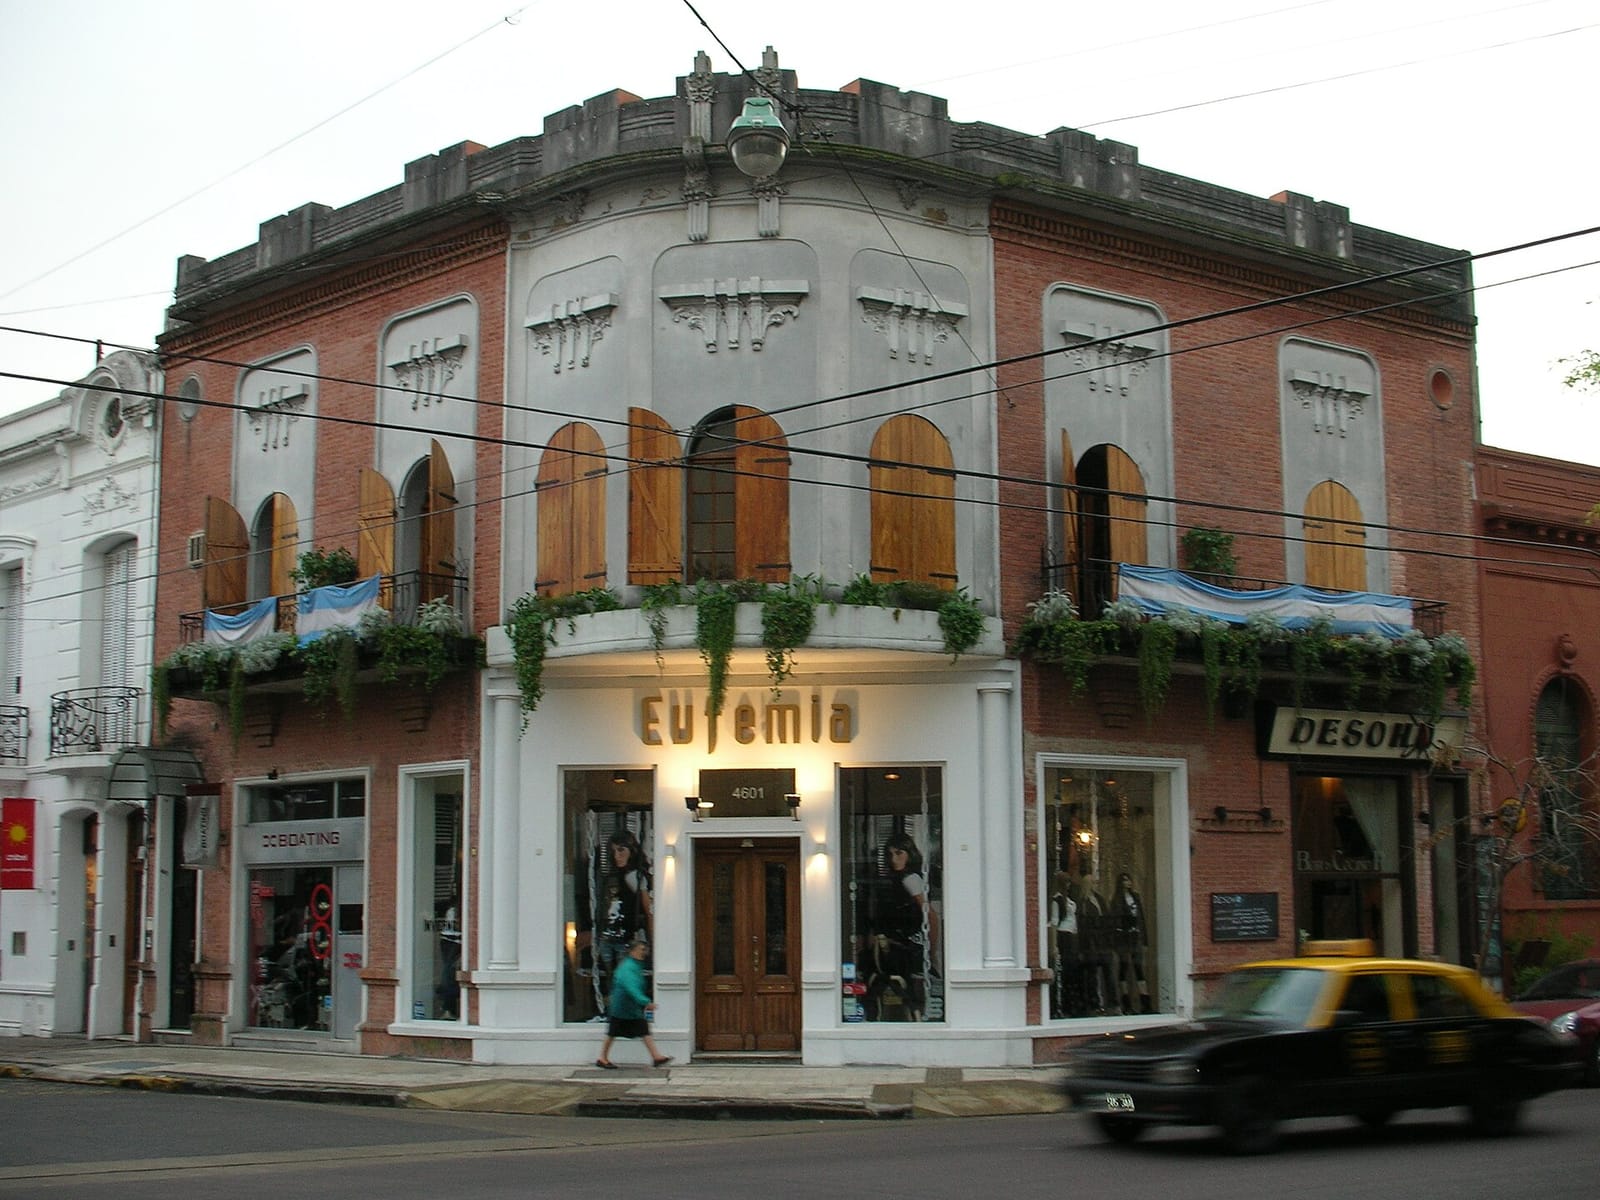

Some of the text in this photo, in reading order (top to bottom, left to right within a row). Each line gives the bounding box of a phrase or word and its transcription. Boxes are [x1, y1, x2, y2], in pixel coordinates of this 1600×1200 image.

[642, 695, 851, 754] Eufemia
[732, 786, 765, 800] 4601
[278, 831, 340, 847] BOATING
